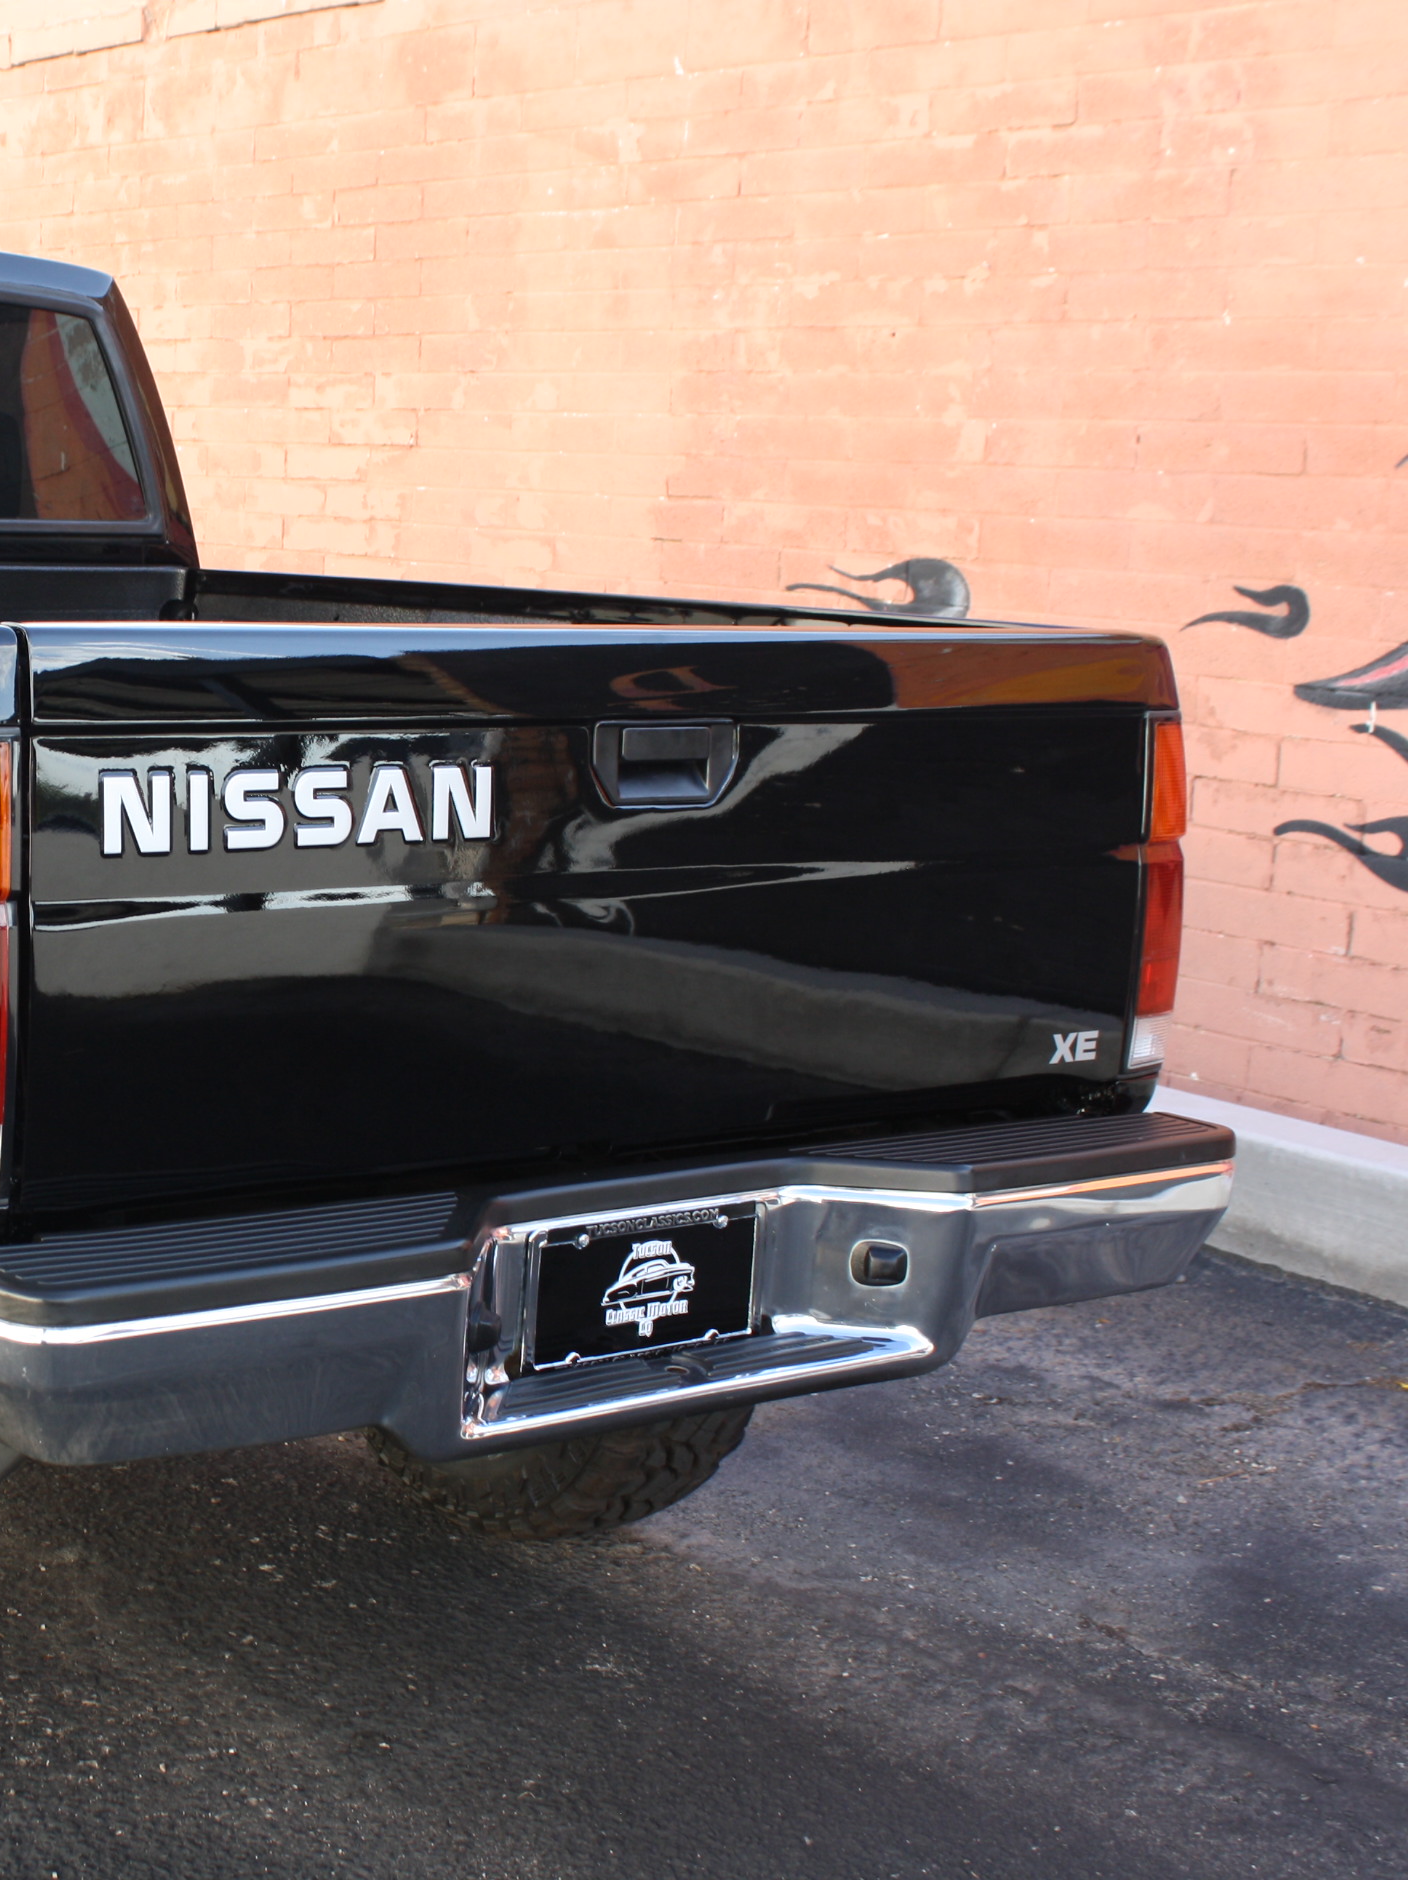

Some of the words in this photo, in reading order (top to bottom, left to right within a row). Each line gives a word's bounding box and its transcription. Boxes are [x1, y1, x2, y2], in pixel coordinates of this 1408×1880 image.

[99, 762, 495, 858] NISSAN
[1049, 1030, 1099, 1065] XE
[586, 1208, 720, 1237] TUCSONCLASSICS.COM
